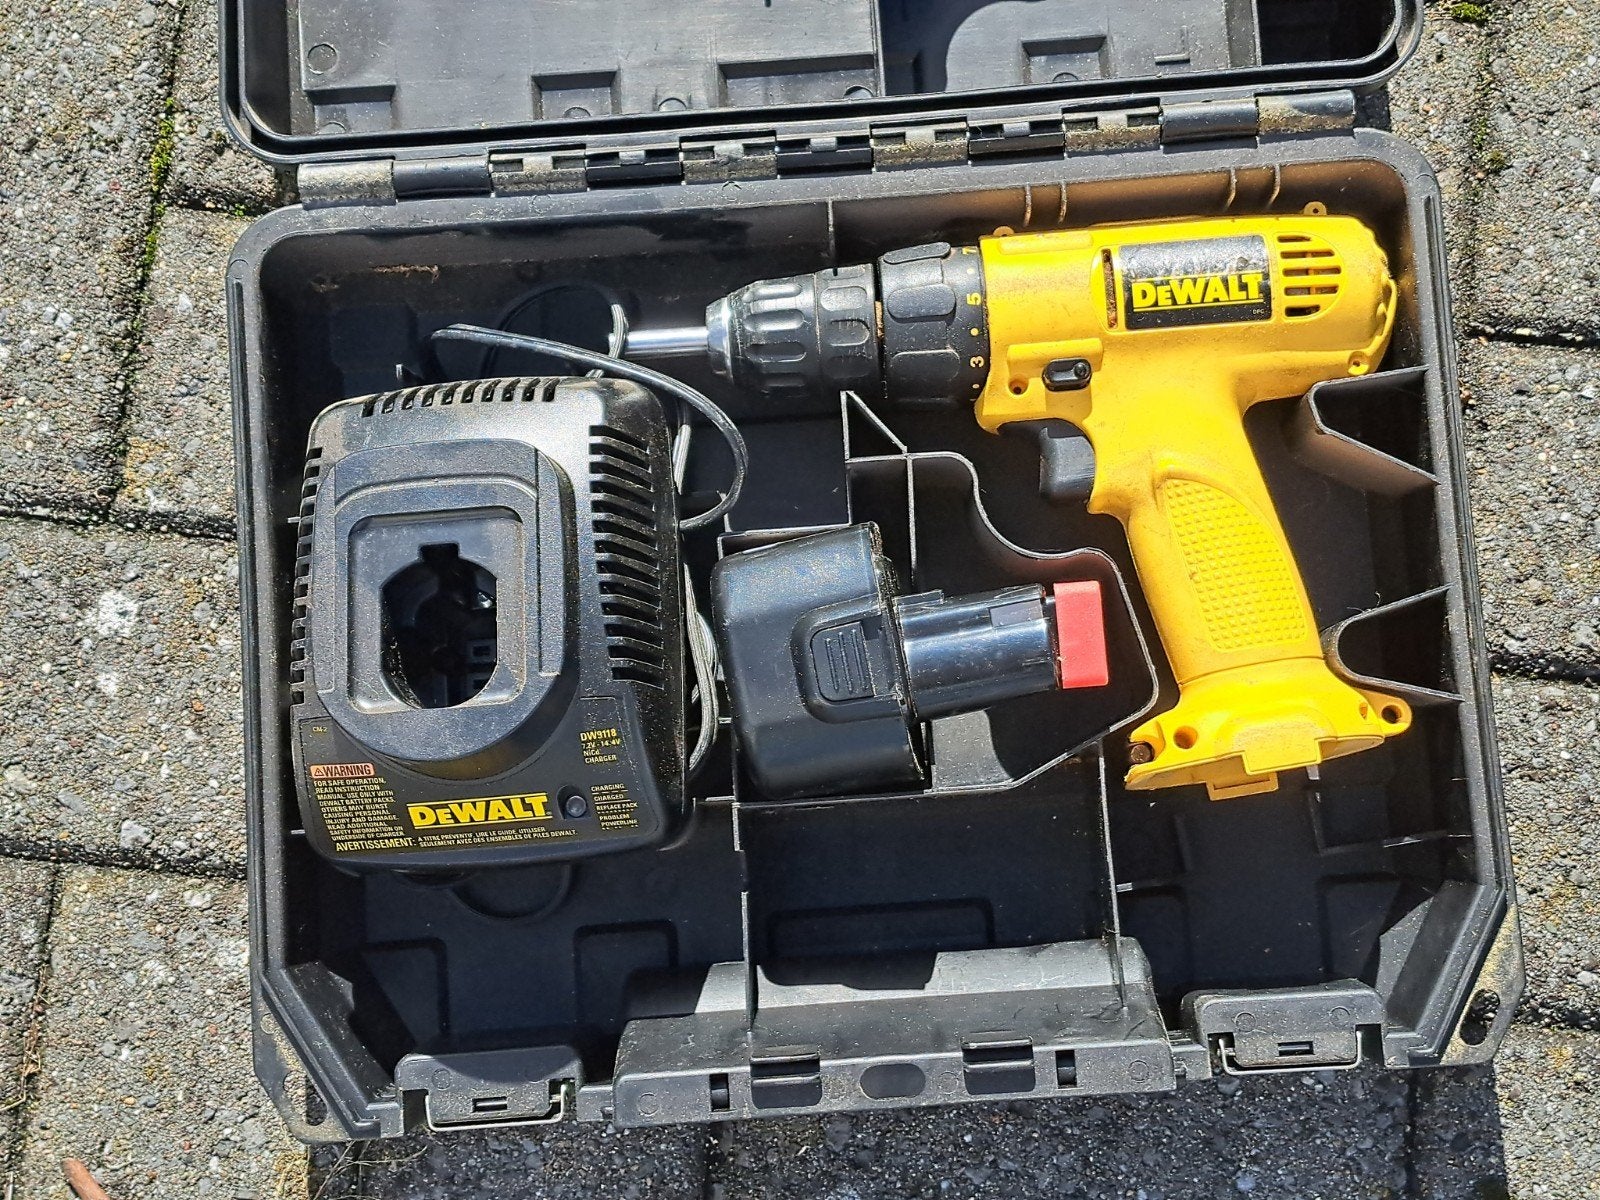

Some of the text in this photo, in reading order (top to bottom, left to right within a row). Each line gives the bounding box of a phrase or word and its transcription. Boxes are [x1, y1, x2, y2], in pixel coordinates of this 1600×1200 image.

[1131, 273, 1263, 308] DEWALT
[966, 292, 981, 305] 5
[970, 355, 984, 368] 3
[580, 729, 617, 741] DW9118
[585, 755, 617, 764] CHARGER
[323, 764, 371, 776] WARNING
[591, 784, 625, 792] CHARGING
[407, 795, 548, 827] DEWALT
[336, 837, 416, 852] AVERTISSEMENT:
[420, 839, 456, 848] SEULEMENT
[486, 834, 523, 843] ENSEMBLES
